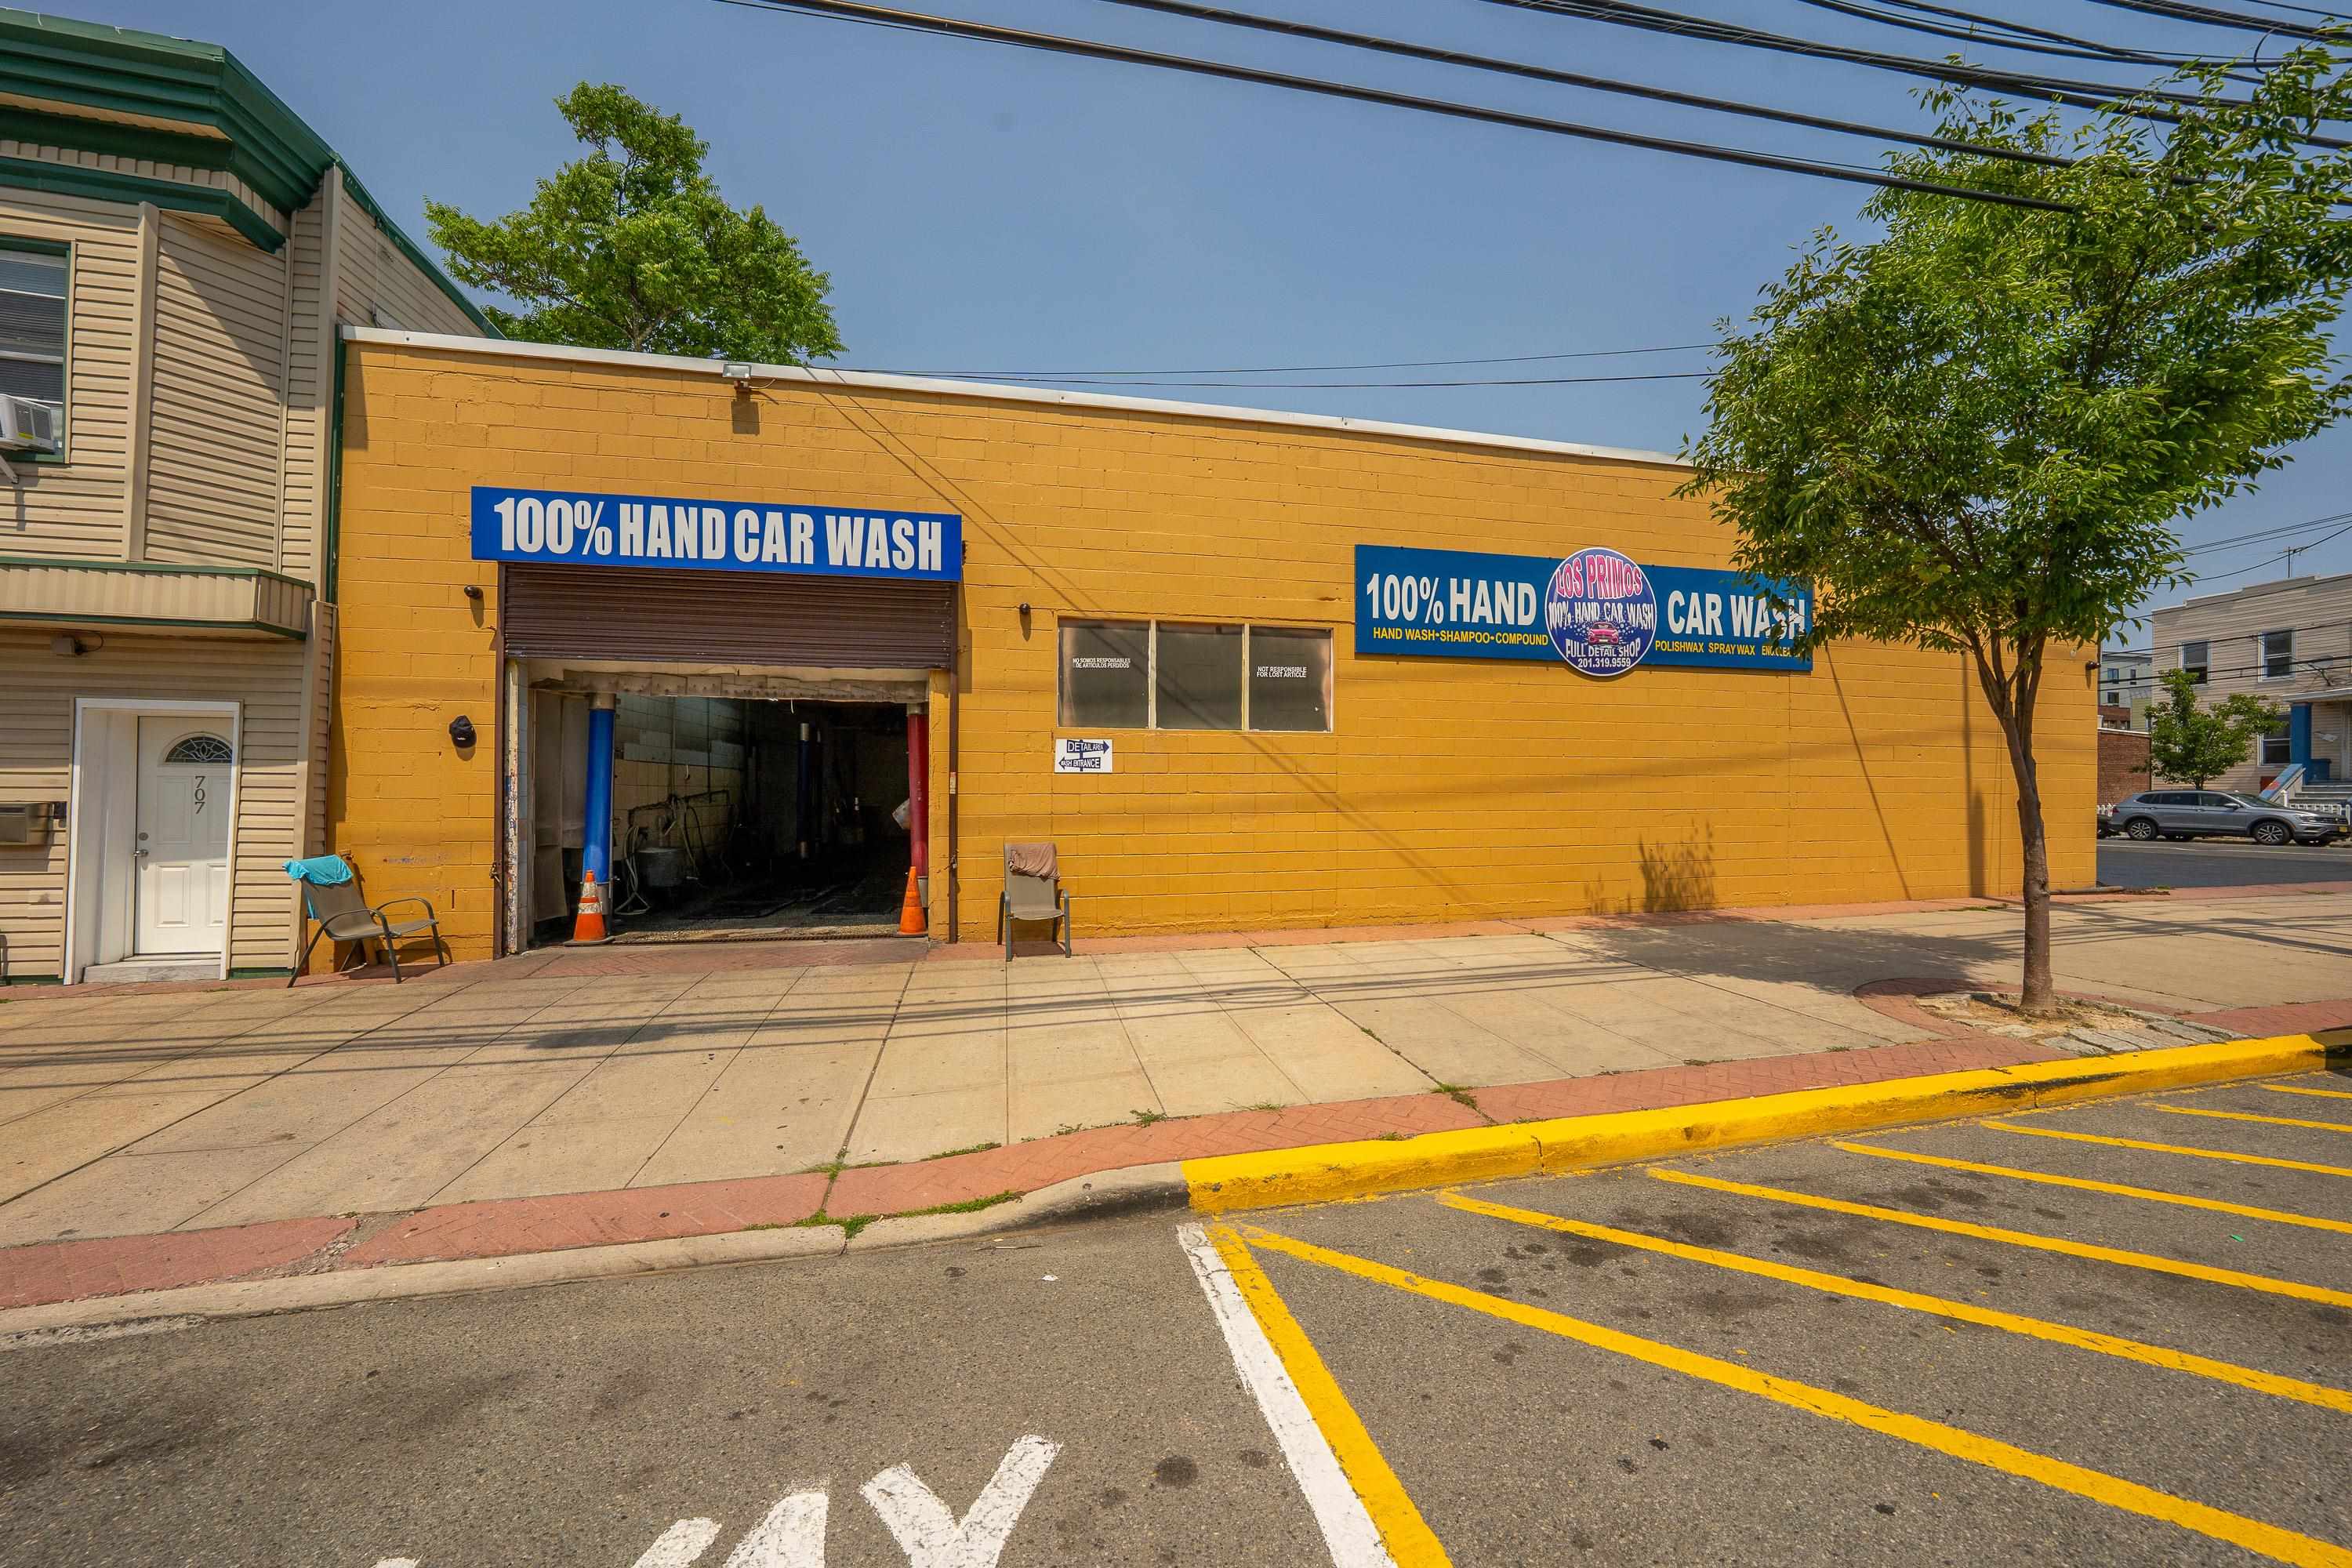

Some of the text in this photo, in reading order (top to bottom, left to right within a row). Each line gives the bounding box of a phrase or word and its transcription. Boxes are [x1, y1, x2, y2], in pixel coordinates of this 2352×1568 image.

[494, 497, 942, 571] 100% HAND CAR WASH
[1556, 555, 1642, 599] LOS PRIMOS
[1367, 573, 1537, 626] 100% HAND
[1548, 601, 1654, 631] 100% HAND CAR WASH
[1668, 590, 1806, 640] CAR WASH
[1373, 626, 1548, 646] HAND WASH SHAMPOO COMPOUND
[1565, 637, 1641, 658] FULL DETAIL SHOP
[1655, 640, 1704, 653] POLISHWAX
[1708, 642, 1737, 655] SPRAY
[1737, 644, 1755, 656] WAX
[1577, 658, 1632, 668] 201.319.9559
[1067, 741, 1093, 751] DETAIL
[1073, 758, 1101, 768] ENTRANCE
[194, 775, 205, 814] 707
